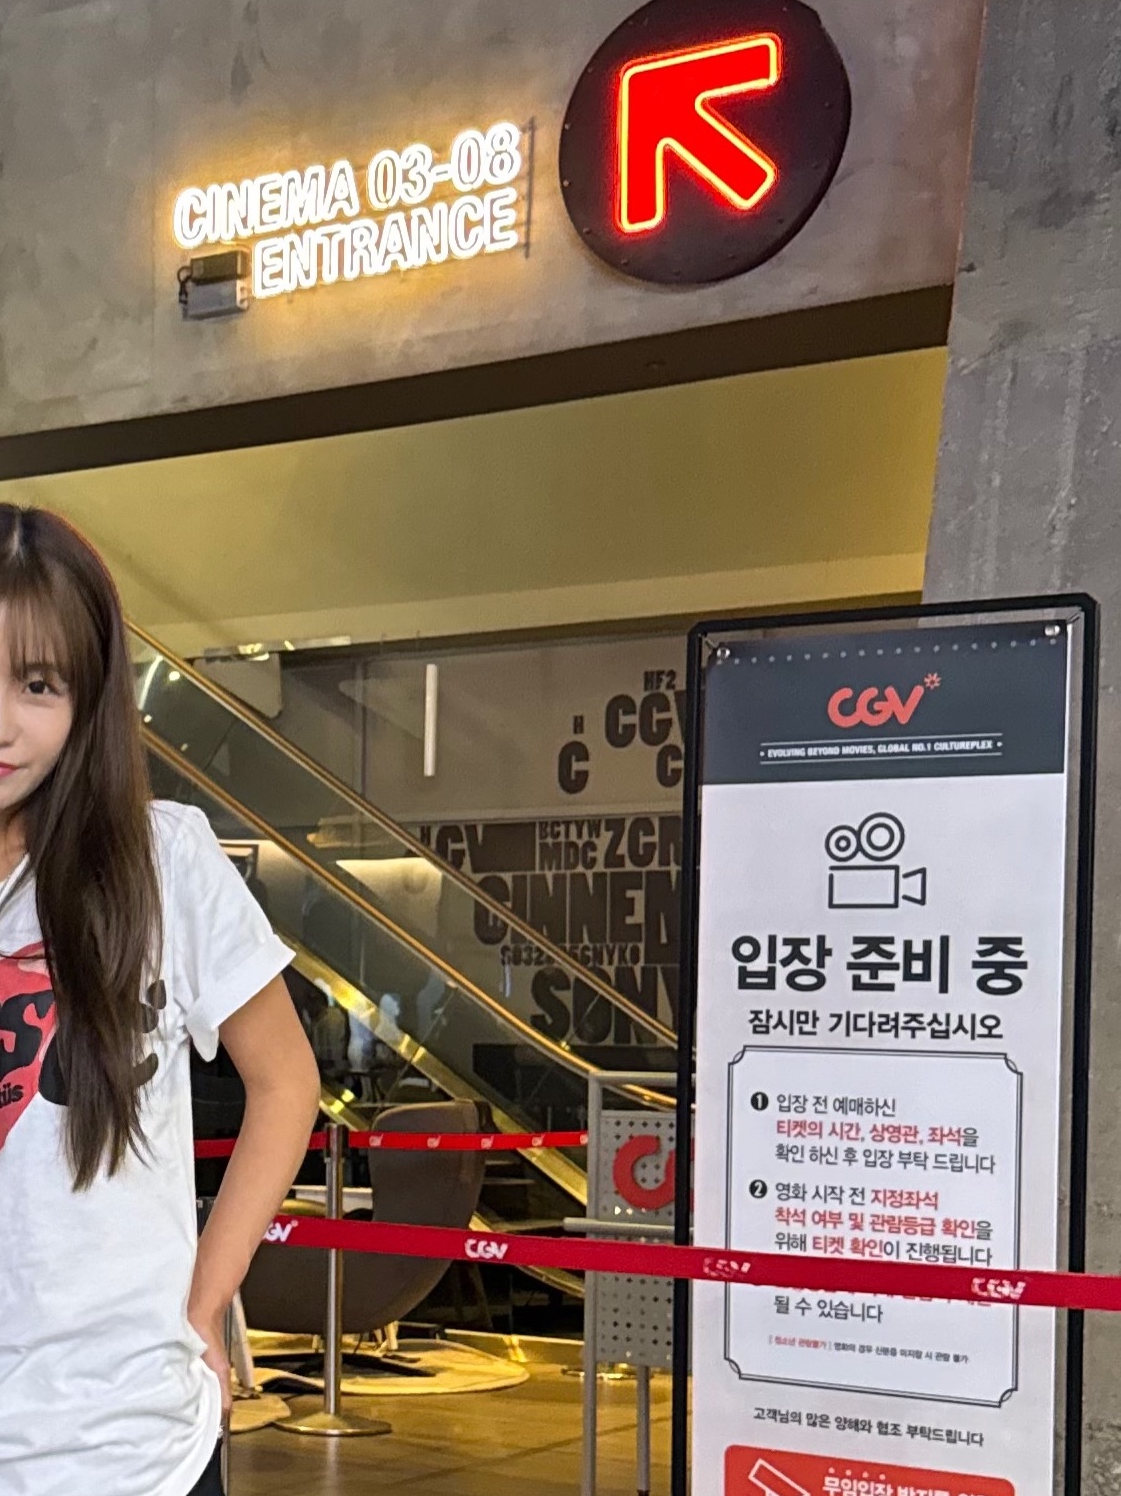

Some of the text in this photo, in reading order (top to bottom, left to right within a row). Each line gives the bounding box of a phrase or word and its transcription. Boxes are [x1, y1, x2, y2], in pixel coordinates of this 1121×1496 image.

[174, 121, 521, 249] CINEMA 03-08
[253, 187, 518, 299] ENTRANCE
[827, 684, 924, 728] CGV
[768, 747, 805, 758] EVOLVING
[808, 746, 839, 757] BEYOND
[878, 743, 910, 754] GLOBAL
[934, 741, 993, 751] CULTUREPLEX
[731, 934, 1028, 996] 입장 준비 중
[748, 1009, 1004, 1040] 잠시만 기다려주십시오
[777, 1094, 808, 1114] 입장
[812, 1095, 828, 1114] 전
[833, 1096, 896, 1118] 예매하신
[776, 1119, 979, 1148] 티켓의 시간, 상영관, 좌석을
[775, 1143, 996, 1174] 확인 하신 후 입장 부탁 드립니다
[776, 1182, 807, 1202] 영화
[812, 1184, 844, 1205] 시작
[848, 1186, 865, 1206] 전
[871, 1188, 939, 1211] 지정좌석
[263, 1222, 292, 1242] GV
[775, 1207, 993, 1241] 착석 여부 및 관람등급 확인을
[465, 1238, 508, 1259] CGV
[775, 1232, 992, 1266] 위해 티켓 확인이 진행됩니다
[774, 1295, 884, 1323] 될 수 있습니다
[754, 1407, 984, 1447] 고객님의 많은 양해와 협조 부탁드립니다
